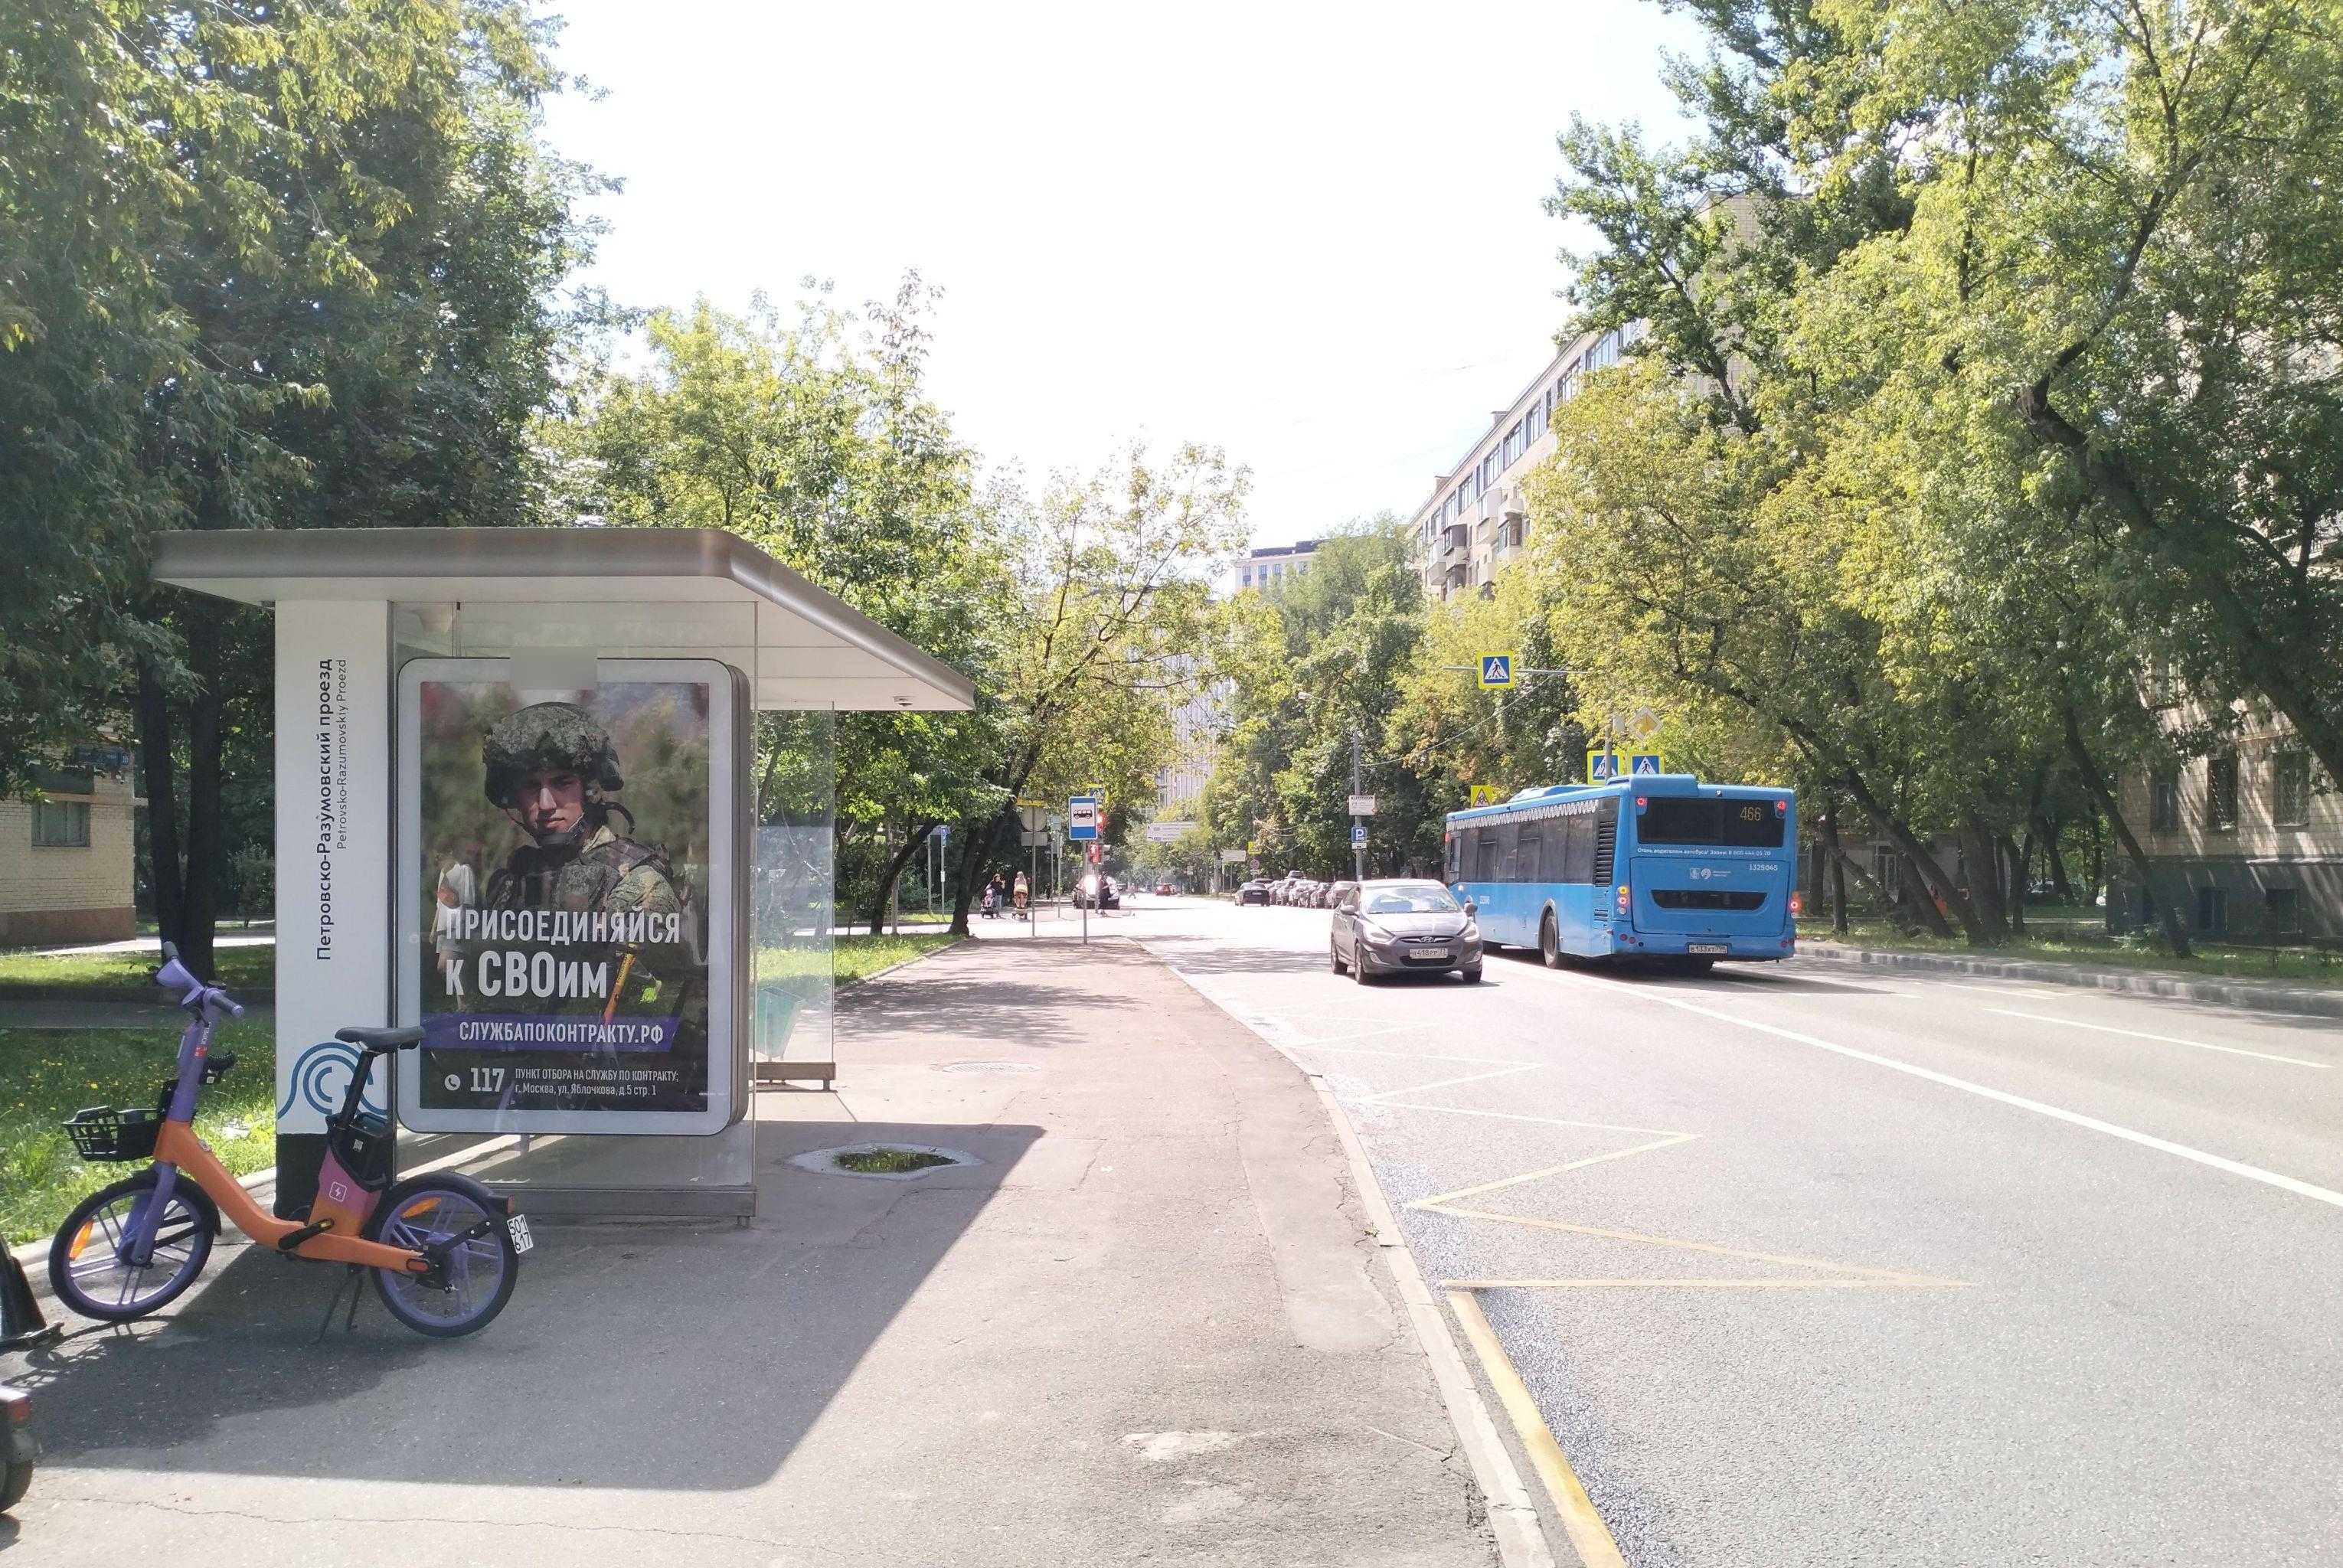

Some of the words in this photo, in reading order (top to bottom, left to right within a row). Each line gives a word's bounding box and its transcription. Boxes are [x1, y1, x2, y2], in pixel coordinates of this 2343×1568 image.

[335, 658, 347, 701] Proezd
[319, 658, 334, 726] проезд
[335, 704, 349, 849] Petrovsko-Razumovskiy
[1740, 806, 1762, 822] 466
[446, 906, 681, 946] ПРИСОЕДИНЯЙСЯ
[459, 1021, 665, 1044] СЛУЖБАПОКОНТРАКТУ.РФ
[469, 1067, 505, 1092] 117
[515, 1068, 542, 1080] ПУНКТ
[542, 1069, 572, 1080] ОТБОРА
[573, 1070, 585, 1080] НА
[585, 1070, 616, 1081] СЛУЖБУ
[619, 1070, 630, 1081] ПО
[523, 1083, 557, 1095] Москва,
[557, 1086, 569, 1096] ул.
[570, 1084, 619, 1096] Яблочкова,
[633, 1086, 650, 1097] стр.
[651, 1085, 656, 1096] 1
[508, 1216, 528, 1236] 501
[515, 1231, 531, 1251] 617
